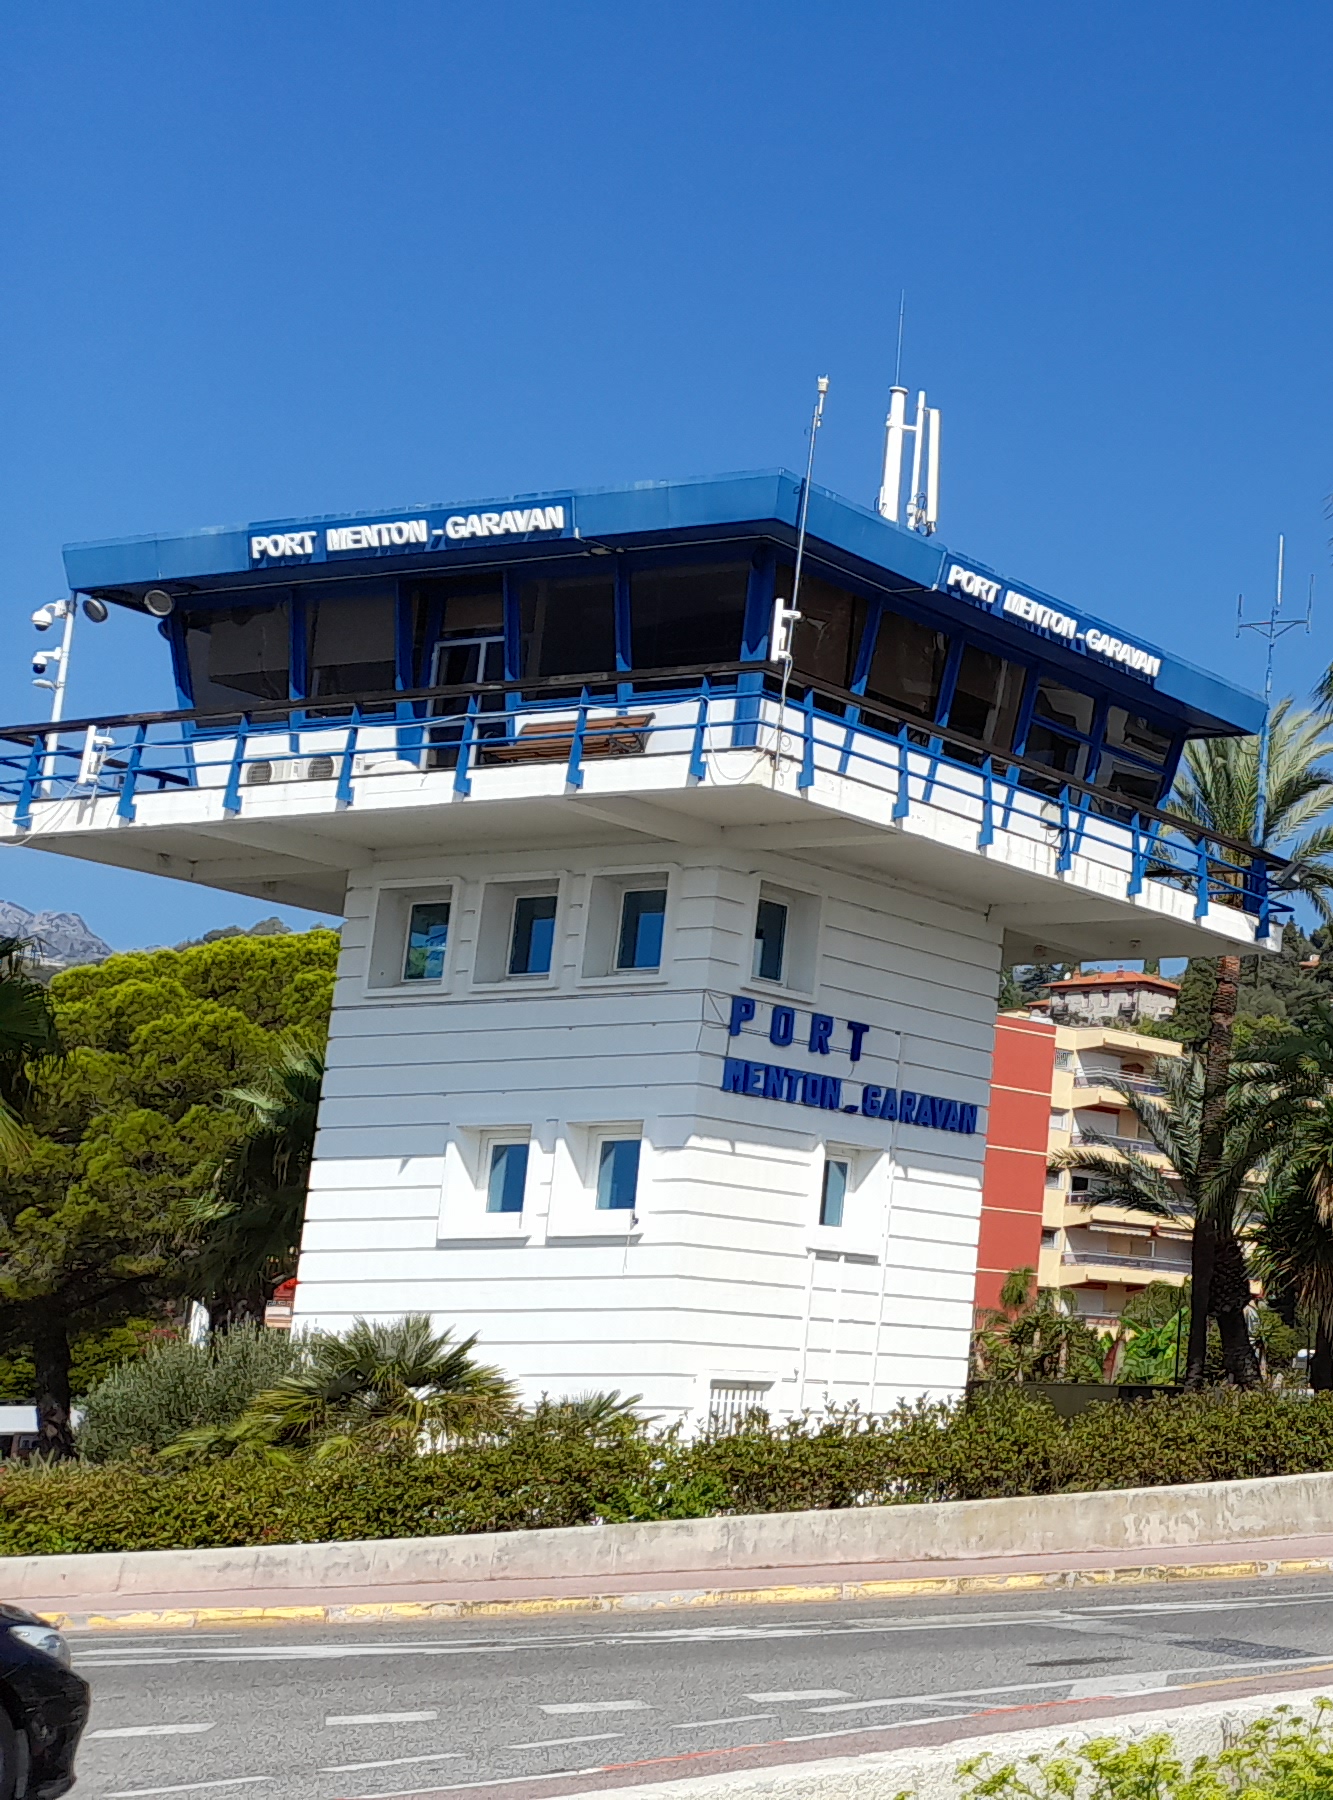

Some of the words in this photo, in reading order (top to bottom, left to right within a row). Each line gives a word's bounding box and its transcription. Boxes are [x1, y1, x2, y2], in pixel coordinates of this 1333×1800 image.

[251, 531, 317, 559] PORT
[947, 564, 1001, 604] PORT
[729, 995, 869, 1062] PORT
